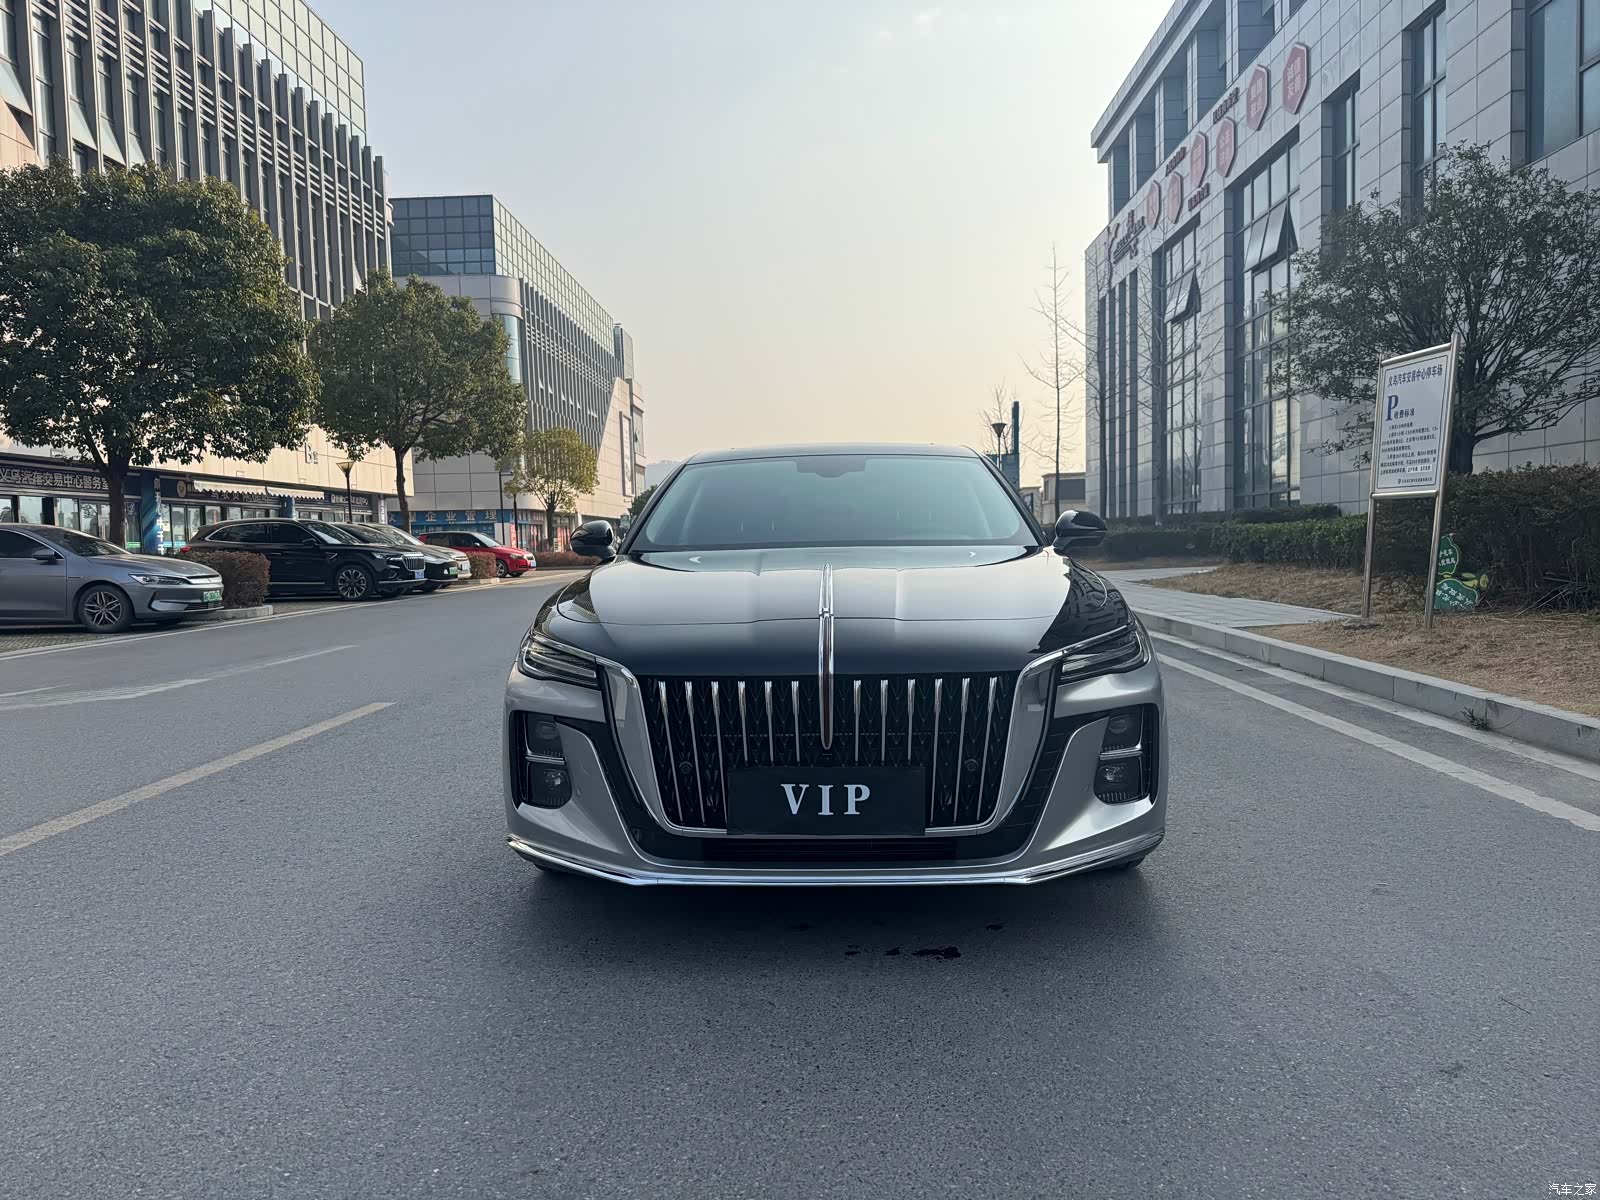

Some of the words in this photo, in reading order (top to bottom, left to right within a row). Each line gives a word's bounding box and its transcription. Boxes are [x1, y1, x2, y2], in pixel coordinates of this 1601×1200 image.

[1387, 364, 1442, 387] 义乌汽车交易中心停车场
[1385, 394, 1399, 421] P
[1393, 407, 1415, 419] 收费标准
[780, 783, 871, 816] VIP
